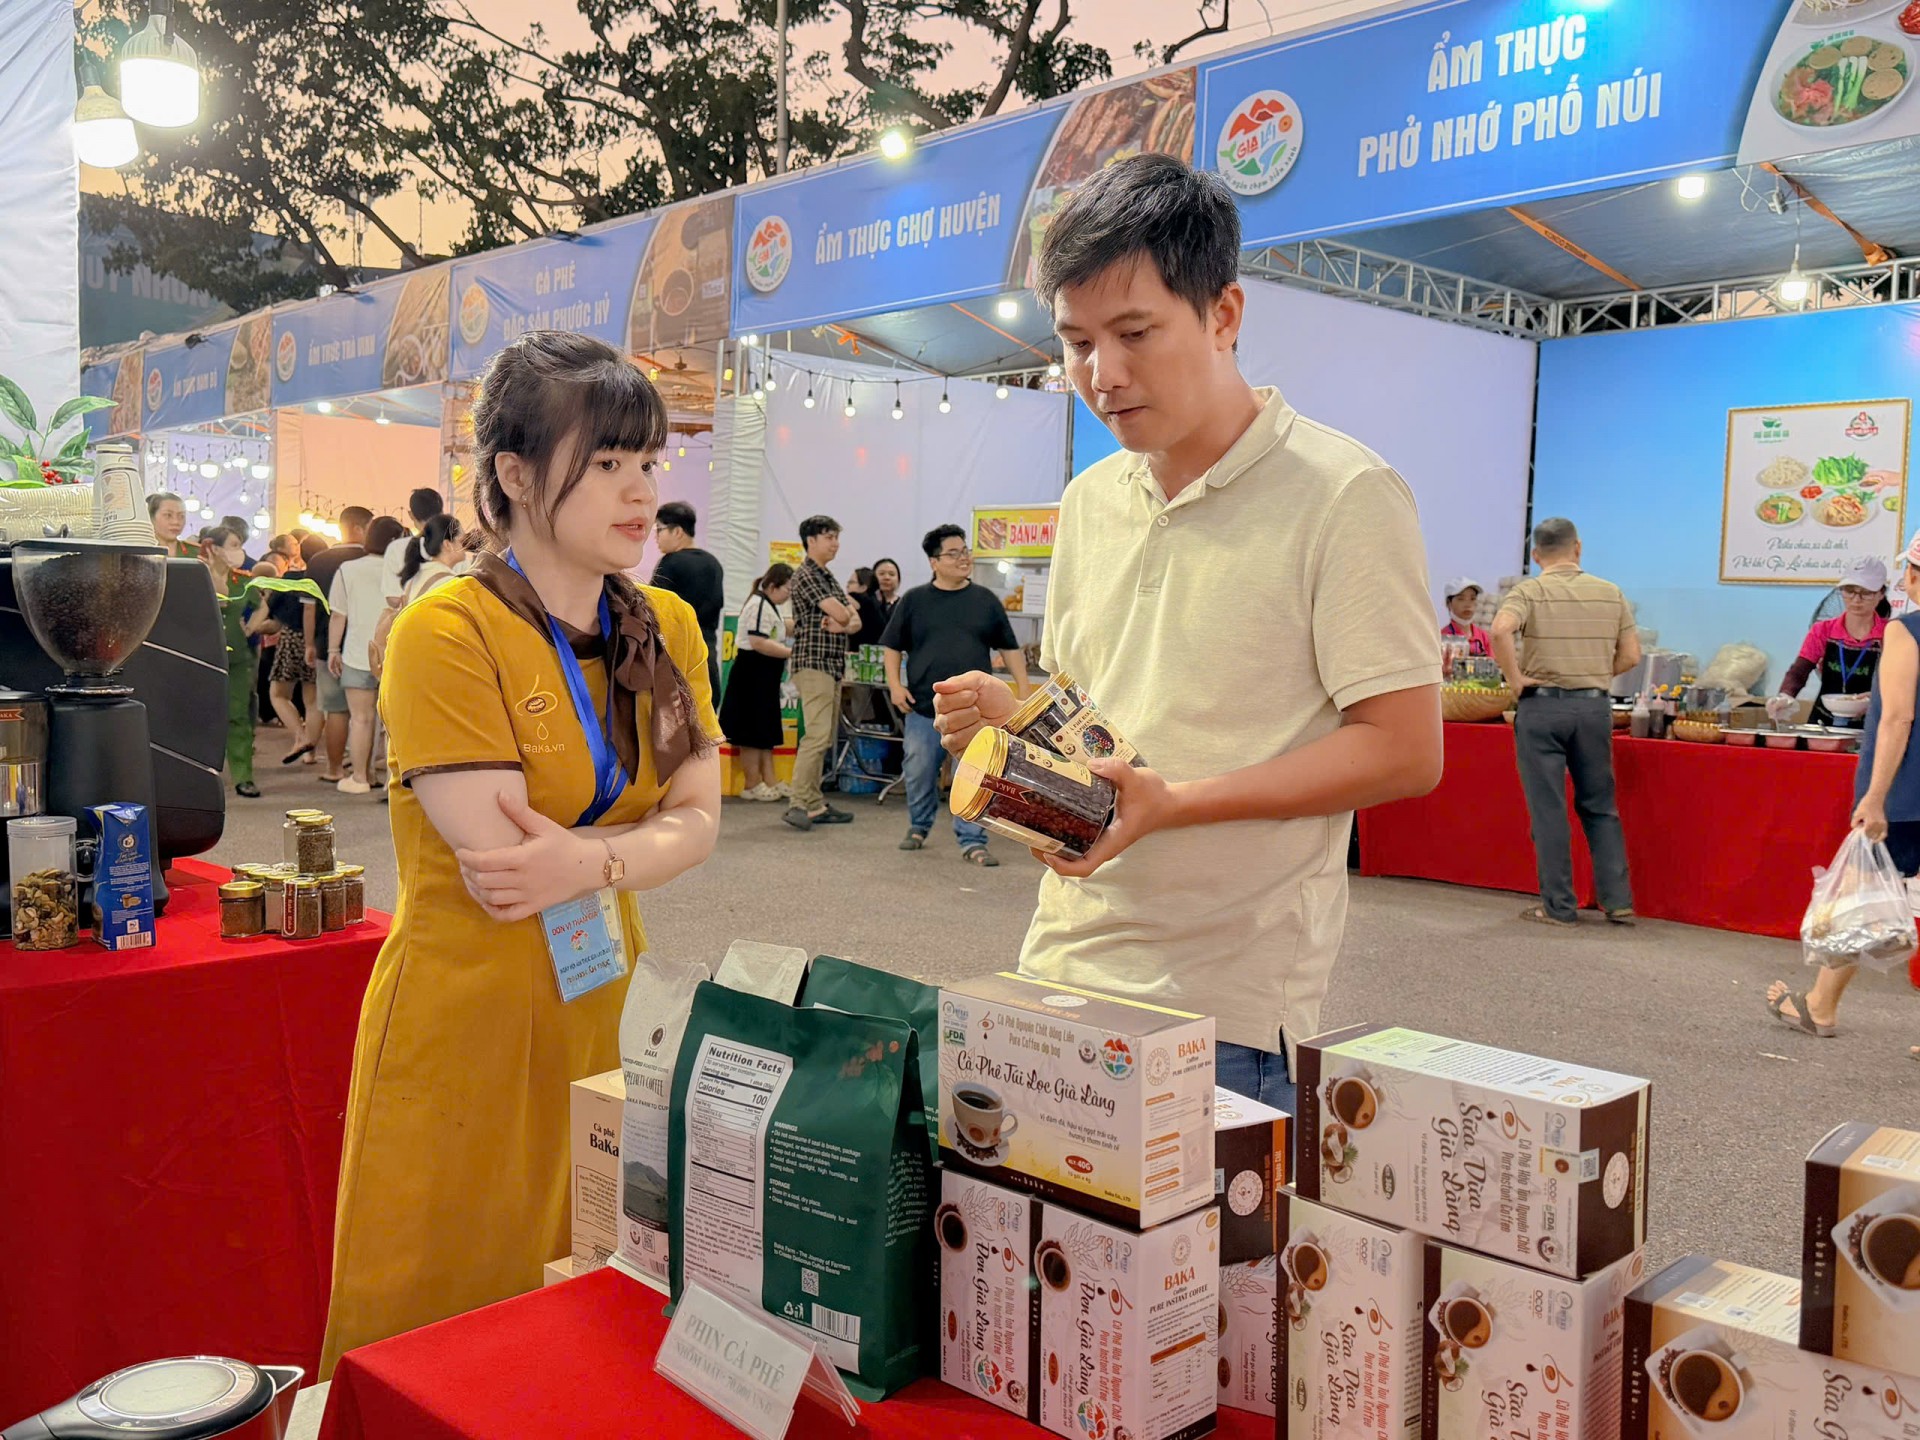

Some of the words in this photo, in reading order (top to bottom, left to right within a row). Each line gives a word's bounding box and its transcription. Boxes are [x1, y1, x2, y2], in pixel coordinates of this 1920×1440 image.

[1427, 31, 1483, 93] ẨM
[1495, 14, 1588, 77] THỰC
[1356, 119, 1422, 178] PHỞ
[1430, 99, 1502, 162] NHỚ
[1512, 71, 1582, 146] PHỐ
[1595, 65, 1663, 129] NÚI
[1236, 136, 1259, 160] GIA
[816, 222, 843, 265] ẨM
[848, 218, 892, 260] THỰC
[897, 207, 934, 249] CHỢ
[939, 191, 1002, 238] HUYỆN
[949, 1030, 965, 1041] FDA
[1177, 1037, 1206, 1058] BAKA
[644, 1049, 657, 1058] BAKA
[709, 1046, 752, 1066] Nutrition
[756, 1060, 782, 1074] Facts
[699, 1081, 726, 1096] Calories
[752, 1093, 768, 1106] 100
[957, 1050, 973, 1071] Cà
[976, 1055, 1001, 1080] Phê
[1004, 1062, 1025, 1086] Túi
[1026, 1069, 1052, 1094] Lọc
[1054, 1078, 1078, 1103] Già
[1080, 1084, 1116, 1118] Làng
[593, 1122, 602, 1133] Cà
[603, 1126, 615, 1139] phê
[1431, 1116, 1458, 1162] Già
[1459, 1102, 1483, 1151] Sữa
[590, 1133, 619, 1158] BaKa
[1518, 1138, 1532, 1150] Cà
[1077, 1160, 1091, 1171] 40G
[1501, 1151, 1514, 1172] Pure
[1518, 1151, 1532, 1168] Phê
[1463, 1156, 1487, 1212] Dừa
[1500, 1173, 1513, 1202] Instant
[1518, 1169, 1531, 1186] Hòa
[1441, 1170, 1465, 1236] Làng
[1517, 1187, 1531, 1202] Tan
[1500, 1203, 1514, 1233] Coffee
[1516, 1203, 1530, 1233] Nguyên
[1547, 1210, 1555, 1231] FDA
[1517, 1234, 1530, 1254] Chất
[976, 1242, 990, 1274] Đen
[972, 1275, 989, 1306] Già
[1164, 1266, 1196, 1291] BAKA
[1080, 1282, 1095, 1316] Đen
[1149, 1297, 1166, 1314] PURE
[1166, 1292, 1188, 1310] INSTANT
[1189, 1284, 1209, 1299] COFFEE
[1535, 1290, 1543, 1319] OCOP
[972, 1309, 990, 1351] Làng
[993, 1330, 1003, 1355] Coffee
[1076, 1317, 1094, 1349] Già
[1100, 1330, 1109, 1347] Pure
[1112, 1331, 1122, 1345] Phê
[1339, 1320, 1357, 1360] Sữa
[684, 1315, 725, 1350] PHIN
[724, 1339, 750, 1369] CÀ
[748, 1354, 786, 1393] PHÊ
[1320, 1330, 1340, 1369] Già
[1378, 1340, 1390, 1352] Cà
[1075, 1353, 1095, 1395] Làng
[1100, 1348, 1109, 1375] Instant
[1112, 1363, 1122, 1375] Tan
[1363, 1351, 1375, 1370] Pure
[1378, 1353, 1390, 1370] Phê
[1099, 1376, 1109, 1402] Coffee
[1111, 1376, 1122, 1402] Nguyên
[1343, 1367, 1360, 1411] Dừa
[1363, 1372, 1375, 1399] Instant
[1378, 1371, 1390, 1386] Hòa
[1822, 1369, 1852, 1415] Sữa
[1327, 1373, 1344, 1428] Làng
[1378, 1387, 1390, 1402] Tan
[1505, 1379, 1528, 1420] Sữa
[1555, 1399, 1570, 1411] Cà
[1363, 1400, 1375, 1428] Coffee
[1376, 1403, 1389, 1430] Nguyên
[1481, 1390, 1505, 1430] Già
[1538, 1411, 1551, 1430] Pure
[1555, 1412, 1570, 1430] Phê
